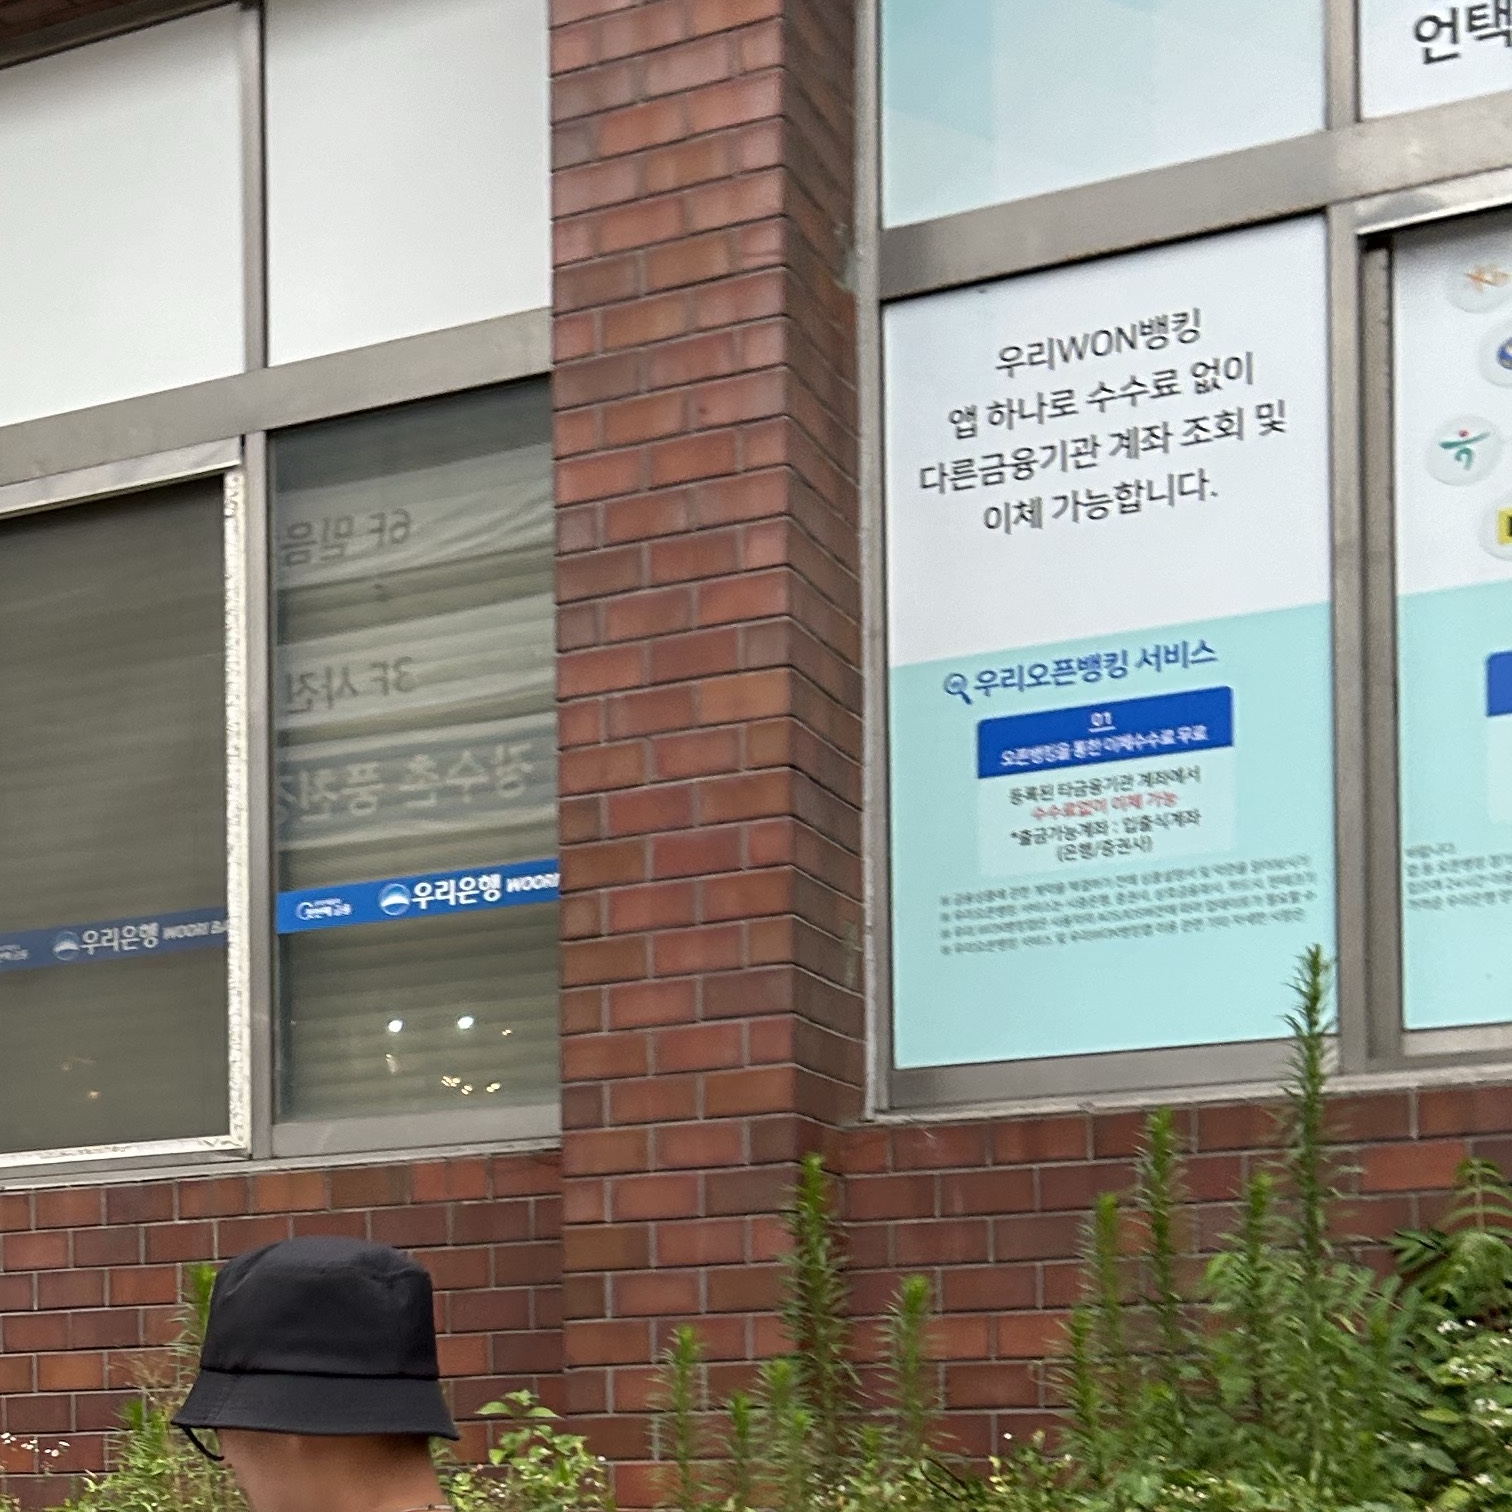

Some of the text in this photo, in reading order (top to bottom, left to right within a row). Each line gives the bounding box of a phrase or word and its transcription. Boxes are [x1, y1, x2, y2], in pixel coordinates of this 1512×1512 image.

[996, 308, 1201, 377] 우리WON뱅킹
[948, 351, 1254, 439] 앱 하나로 수수료 없이
[919, 399, 1287, 494] 다른금융기관 계좌 조회 및
[983, 468, 1218, 535] 이체 가능합니다.
[974, 639, 1218, 697] 우리오픈뱅킹 서비스
[1090, 712, 1113, 728] 01
[412, 873, 502, 910] 우리은행
[80, 922, 160, 955] 우리은행
